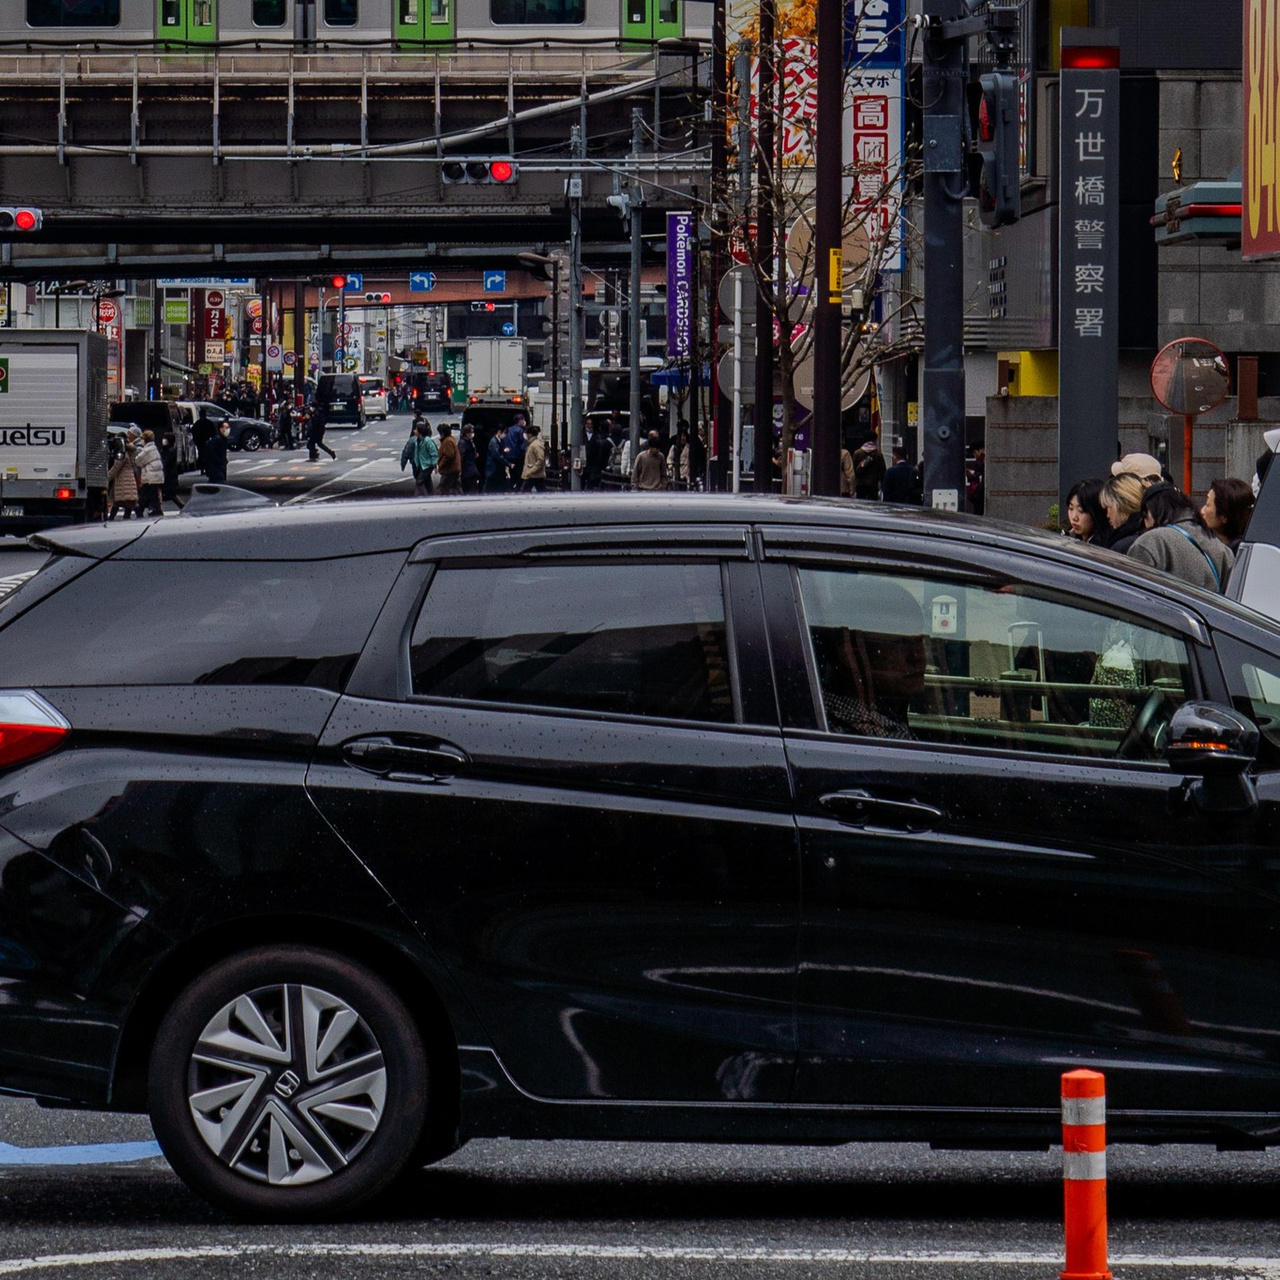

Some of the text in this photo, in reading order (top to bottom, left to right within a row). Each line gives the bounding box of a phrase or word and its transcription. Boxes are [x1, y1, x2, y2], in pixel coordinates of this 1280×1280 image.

[852, 75, 889, 88] スマホ
[1074, 89, 1106, 337] 万世橋警察署
[210, 309, 219, 338] ガスト
